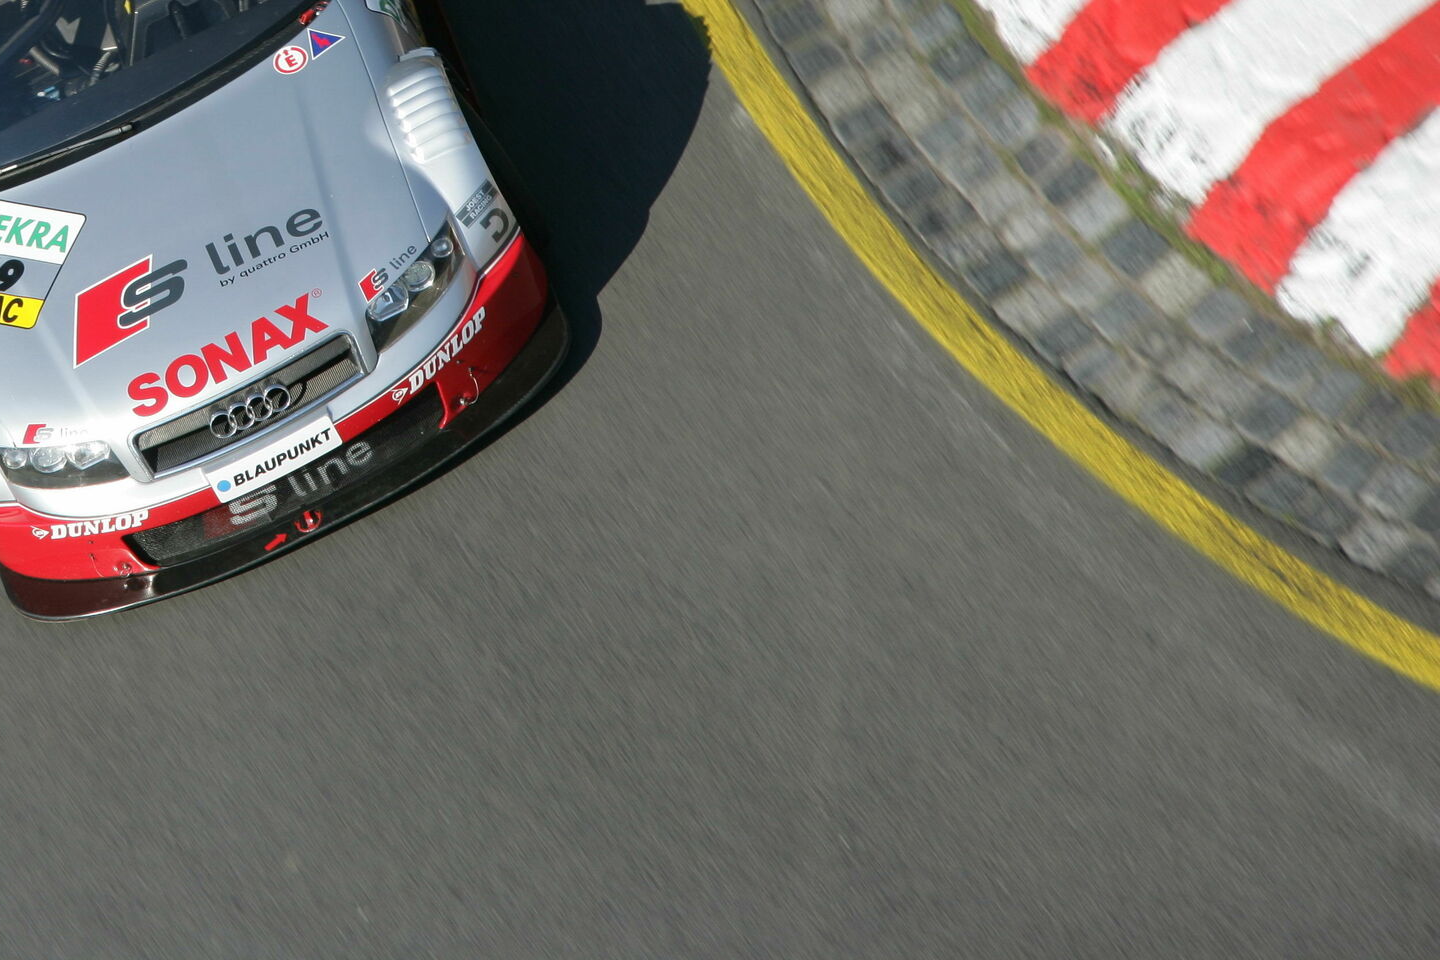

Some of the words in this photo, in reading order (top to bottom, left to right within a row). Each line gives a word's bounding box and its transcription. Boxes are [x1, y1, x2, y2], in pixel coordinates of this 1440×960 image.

[469, 194, 493, 220] RACING
[117, 259, 188, 330] S
[205, 208, 323, 275] line
[220, 275, 236, 288] by
[239, 251, 286, 279] quattro
[289, 231, 330, 255] GmbH
[389, 244, 418, 271] line
[127, 292, 329, 417] SONAX
[409, 306, 487, 395] DUNLOP
[233, 427, 332, 487] BLAUPUNKT
[288, 440, 376, 497] line
[50, 508, 150, 540] DUNLOP
